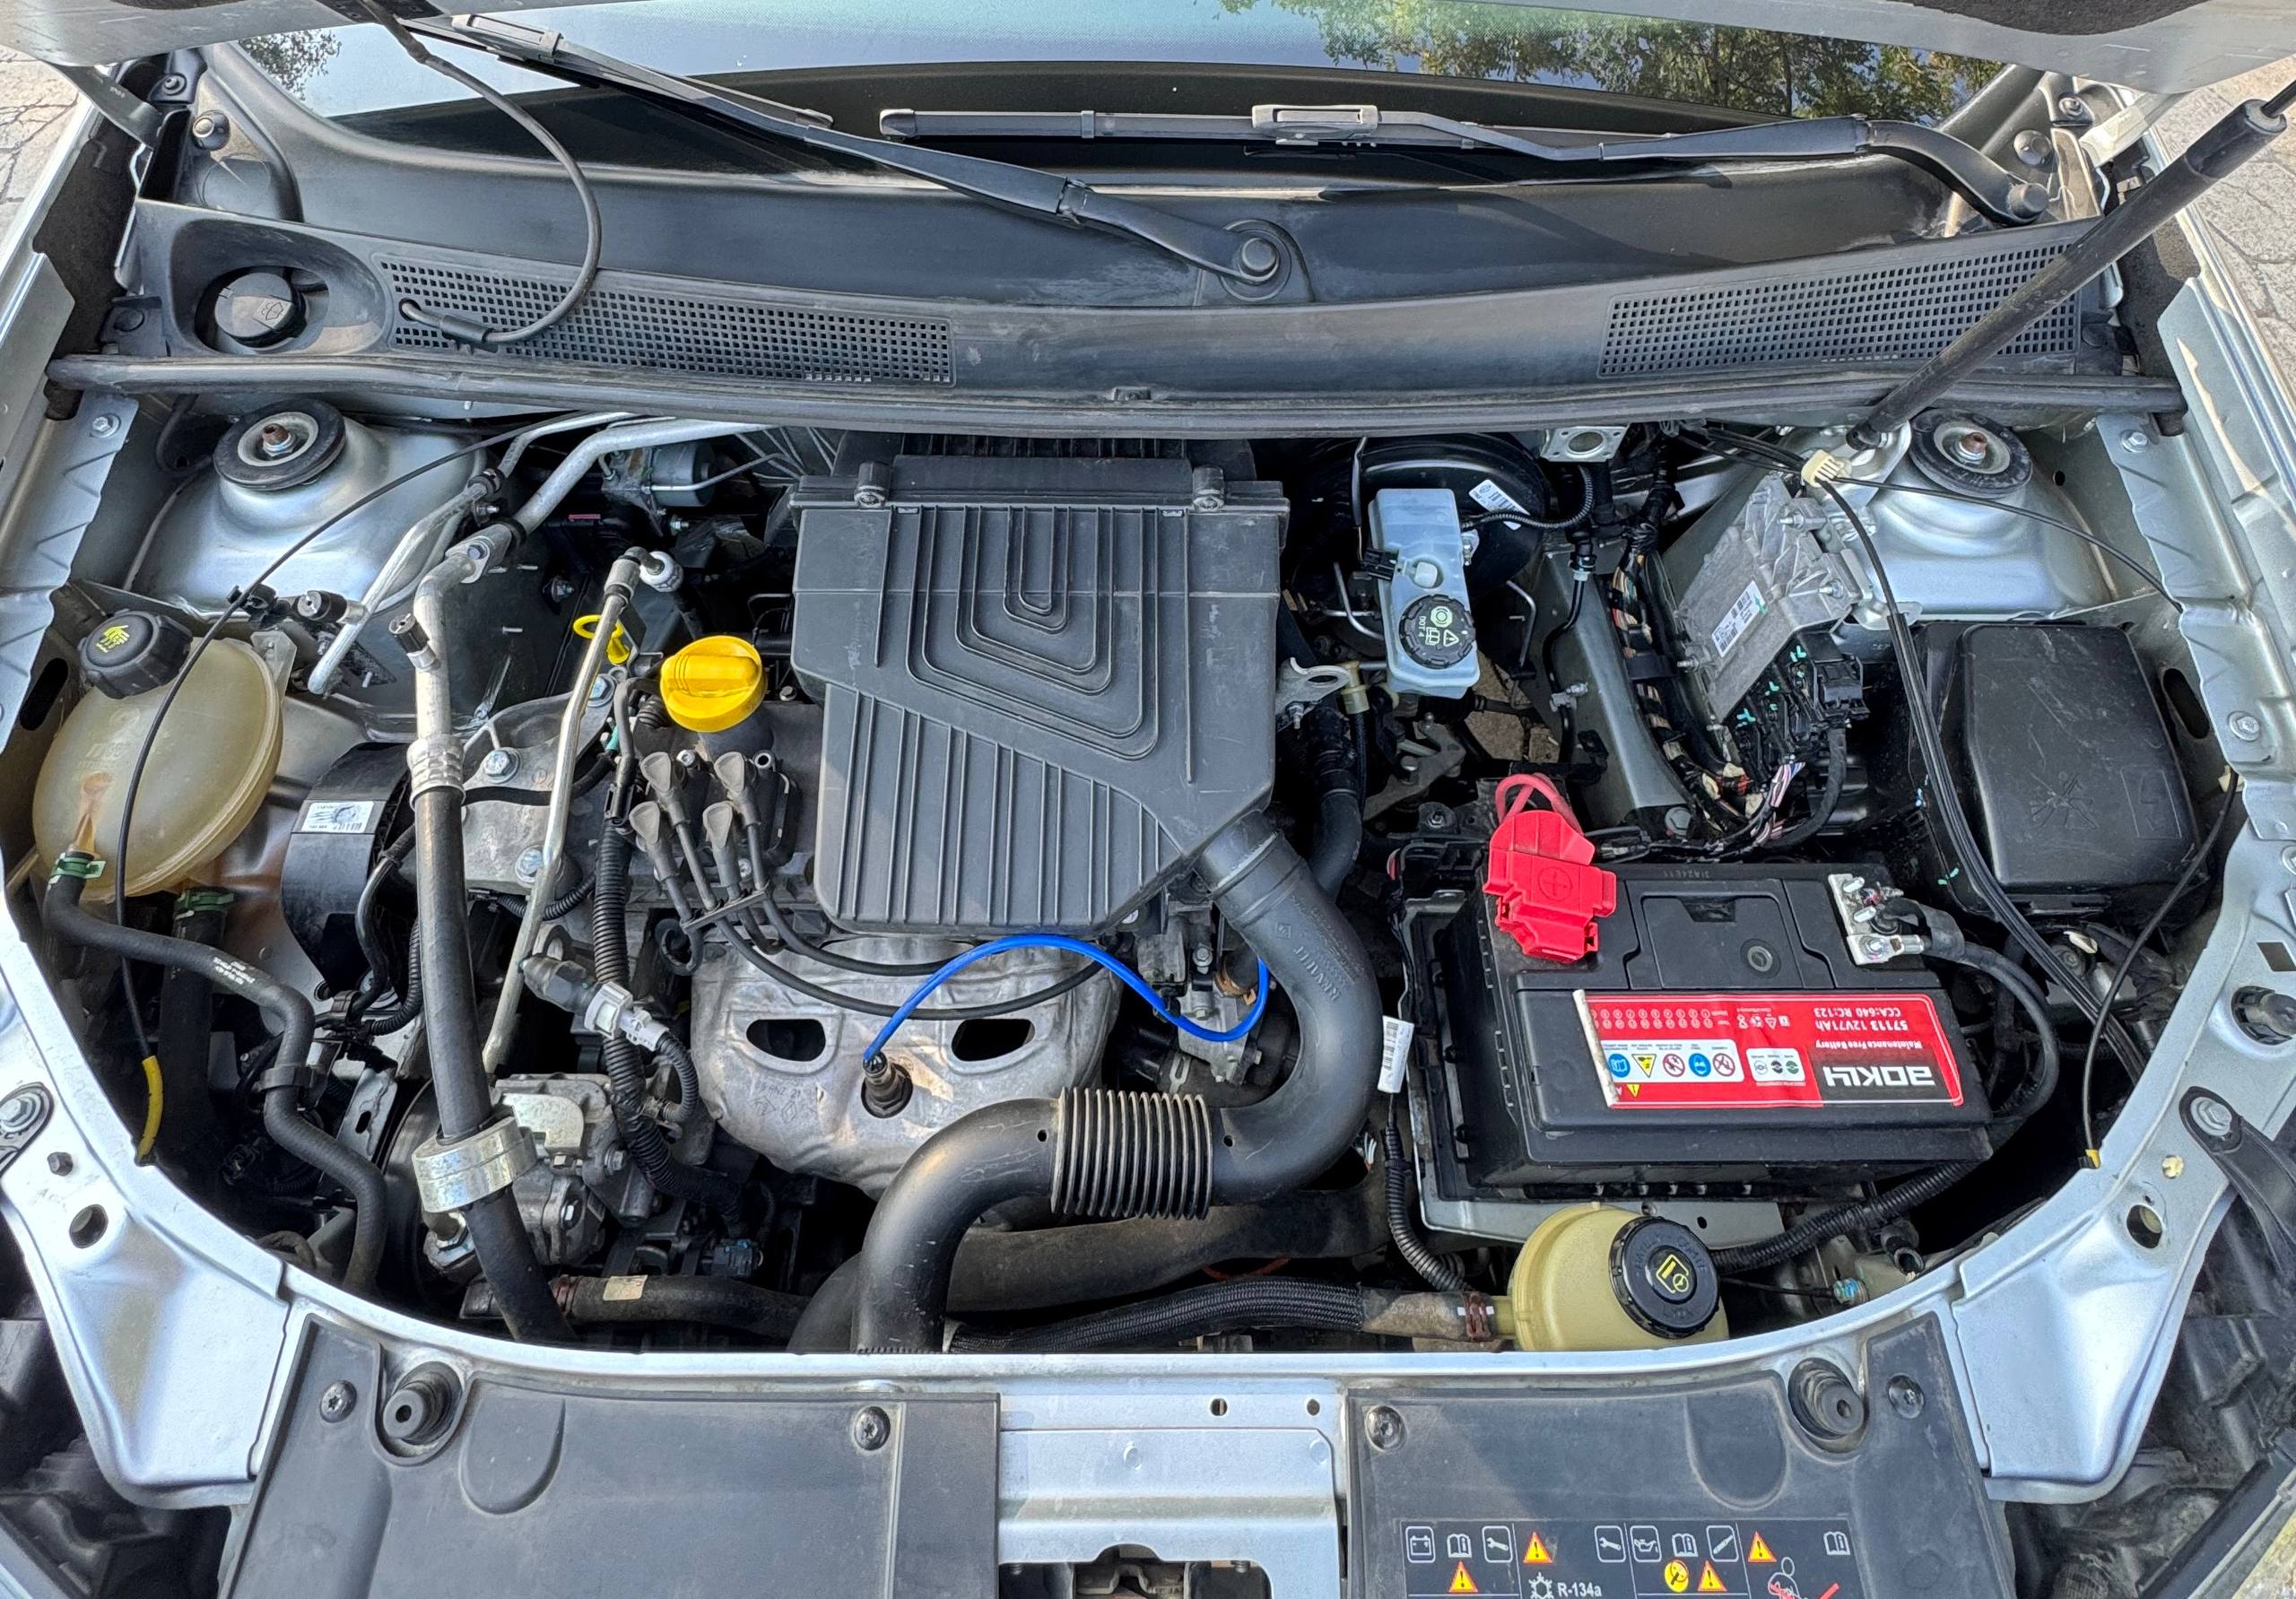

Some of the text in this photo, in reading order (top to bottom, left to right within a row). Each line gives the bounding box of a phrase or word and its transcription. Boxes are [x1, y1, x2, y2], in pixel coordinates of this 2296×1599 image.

[1418, 615, 1426, 631] DOT
[1813, 1007, 1901, 1018] CCA:640 RC:123
[1814, 1020, 1909, 1031] 57113 12V71Ah
[1815, 1039, 1923, 1050] Maintenance Free Battery
[1557, 1581, 1603, 1597] R-134a
